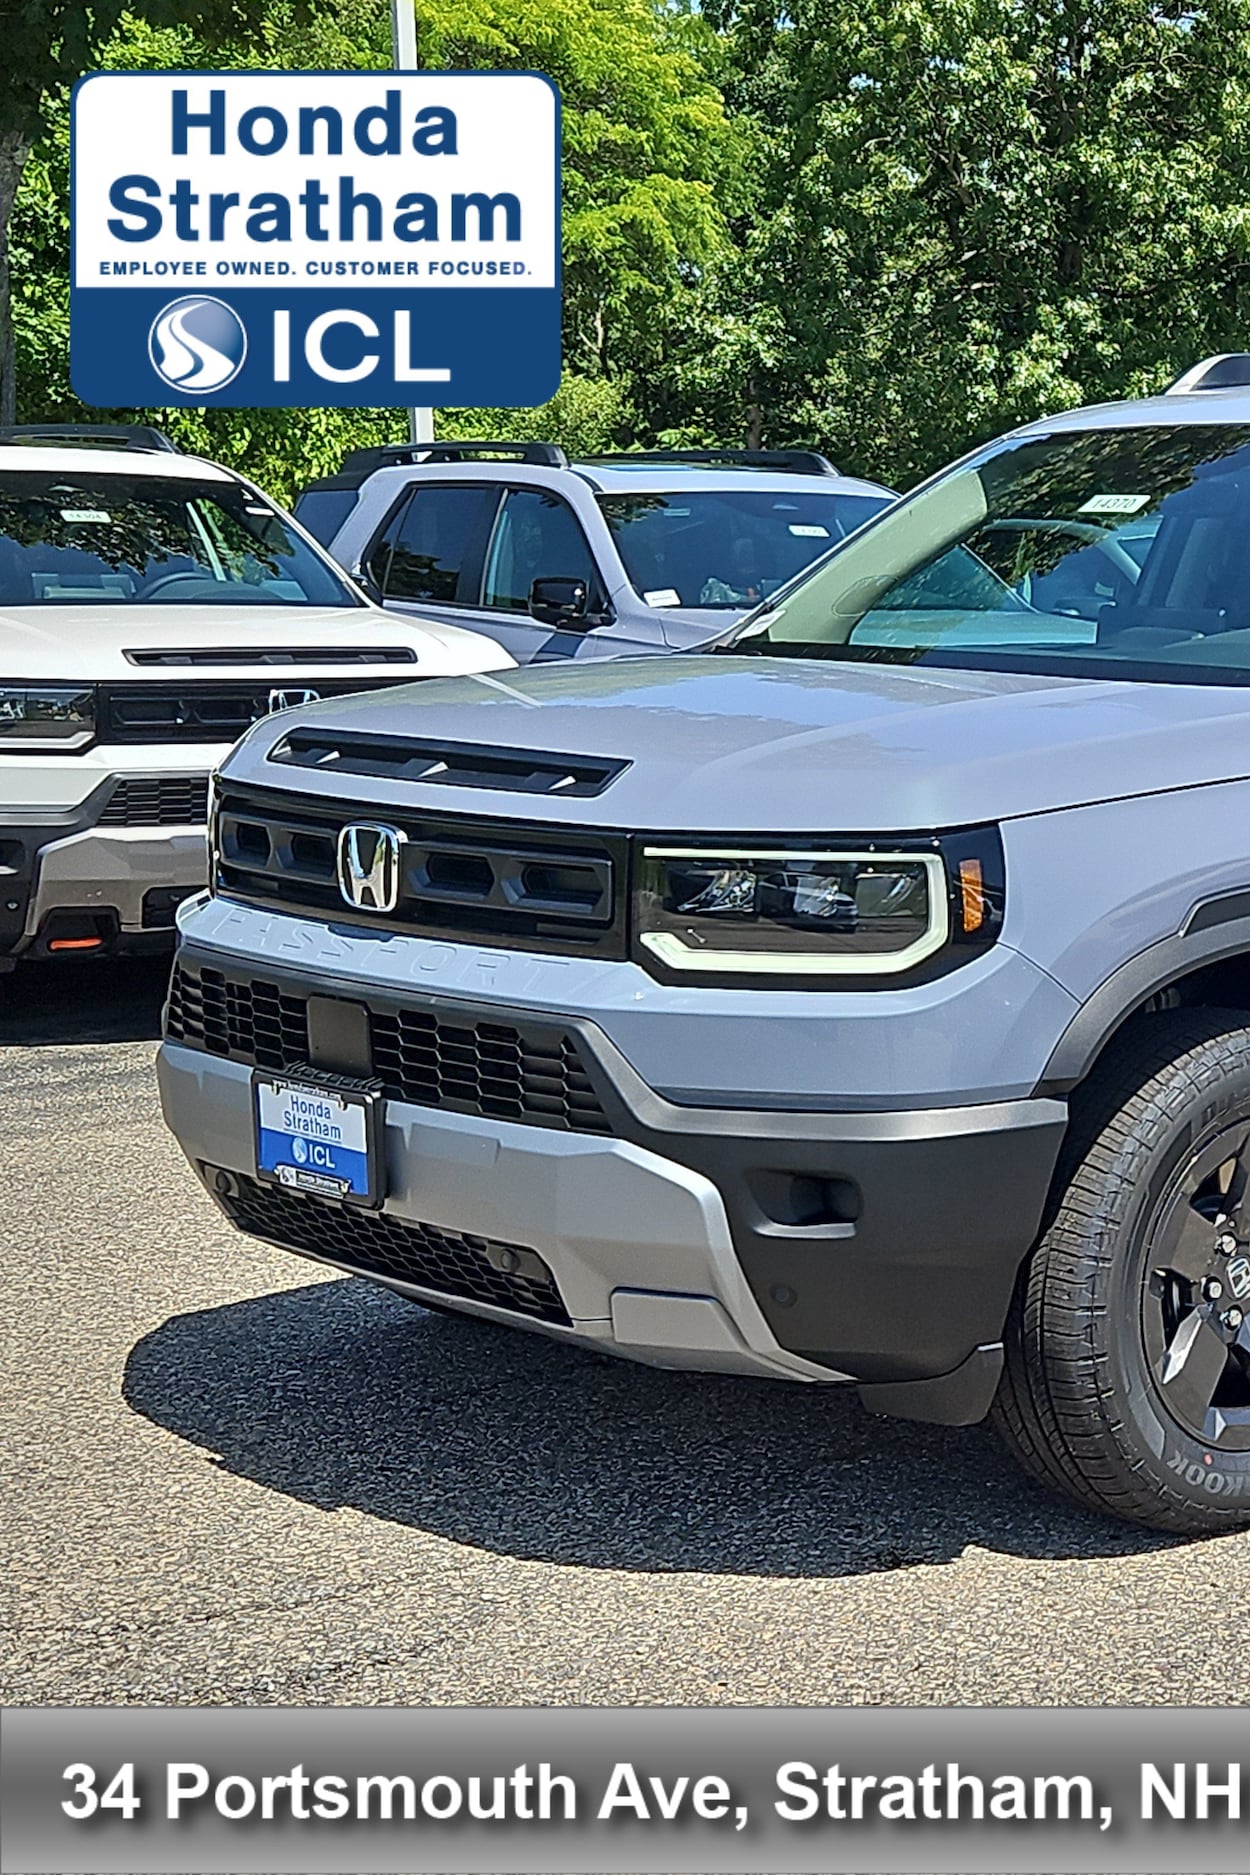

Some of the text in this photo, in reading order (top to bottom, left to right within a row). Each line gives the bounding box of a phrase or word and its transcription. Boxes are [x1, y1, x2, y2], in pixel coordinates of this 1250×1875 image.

[290, 1094, 331, 1120] Honda
[283, 1110, 342, 1140] Stratham
[308, 1143, 336, 1169] ICL
